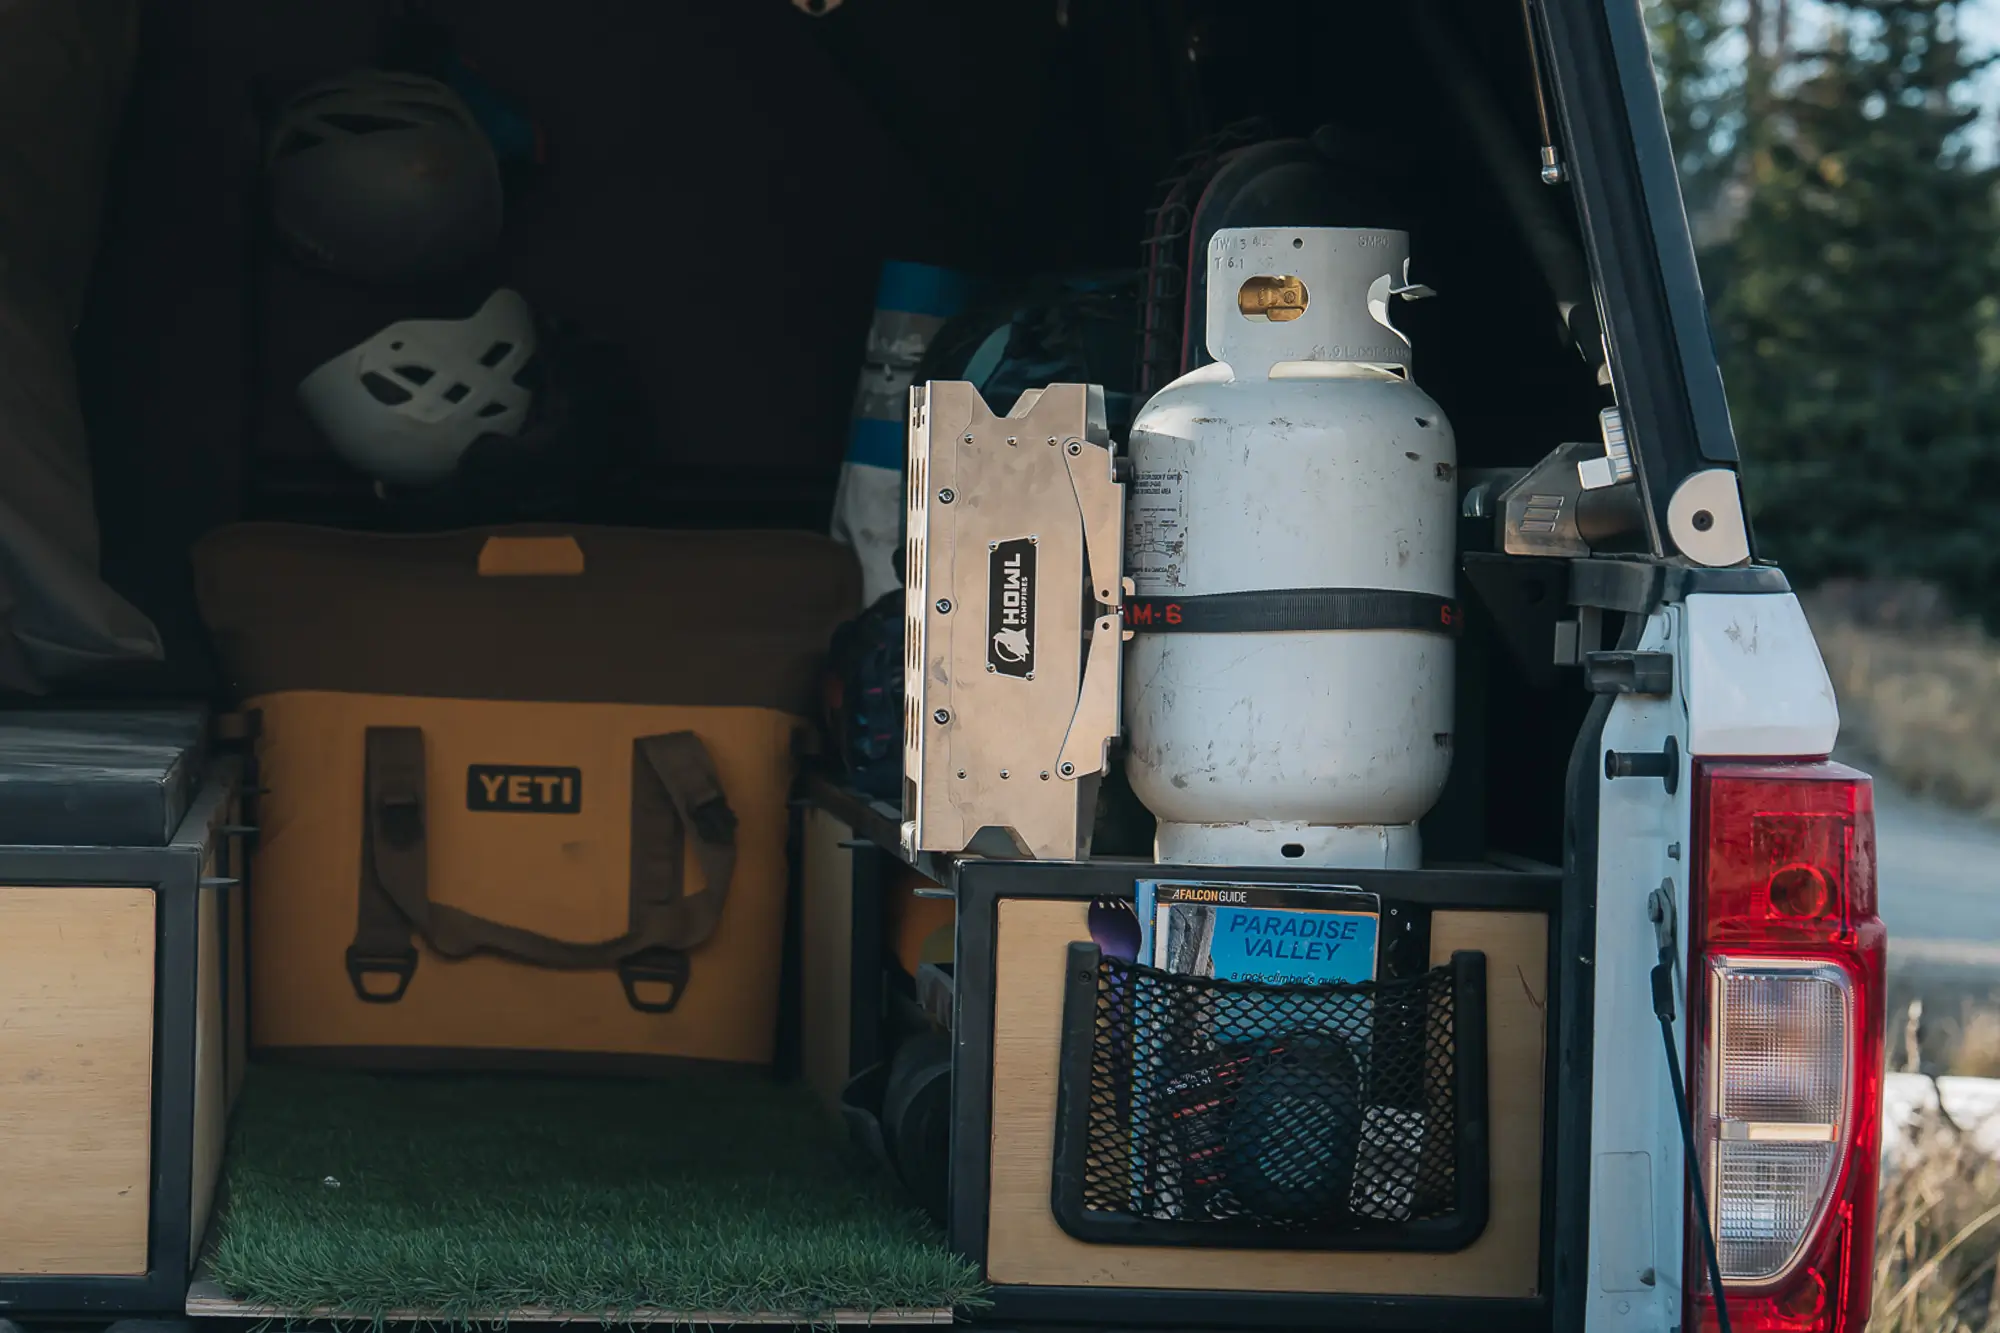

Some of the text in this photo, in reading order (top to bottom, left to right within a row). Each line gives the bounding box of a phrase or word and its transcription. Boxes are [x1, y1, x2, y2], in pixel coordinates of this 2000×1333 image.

[1227, 256, 1245, 271] 6.1
[1002, 553, 1020, 625] HOWL
[1020, 576, 1028, 625] CAMPFIRES
[479, 774, 574, 804] YETI
[1229, 914, 1359, 940] PARADISE
[1244, 937, 1341, 961] VALLEY
[1231, 971, 1238, 980] a
